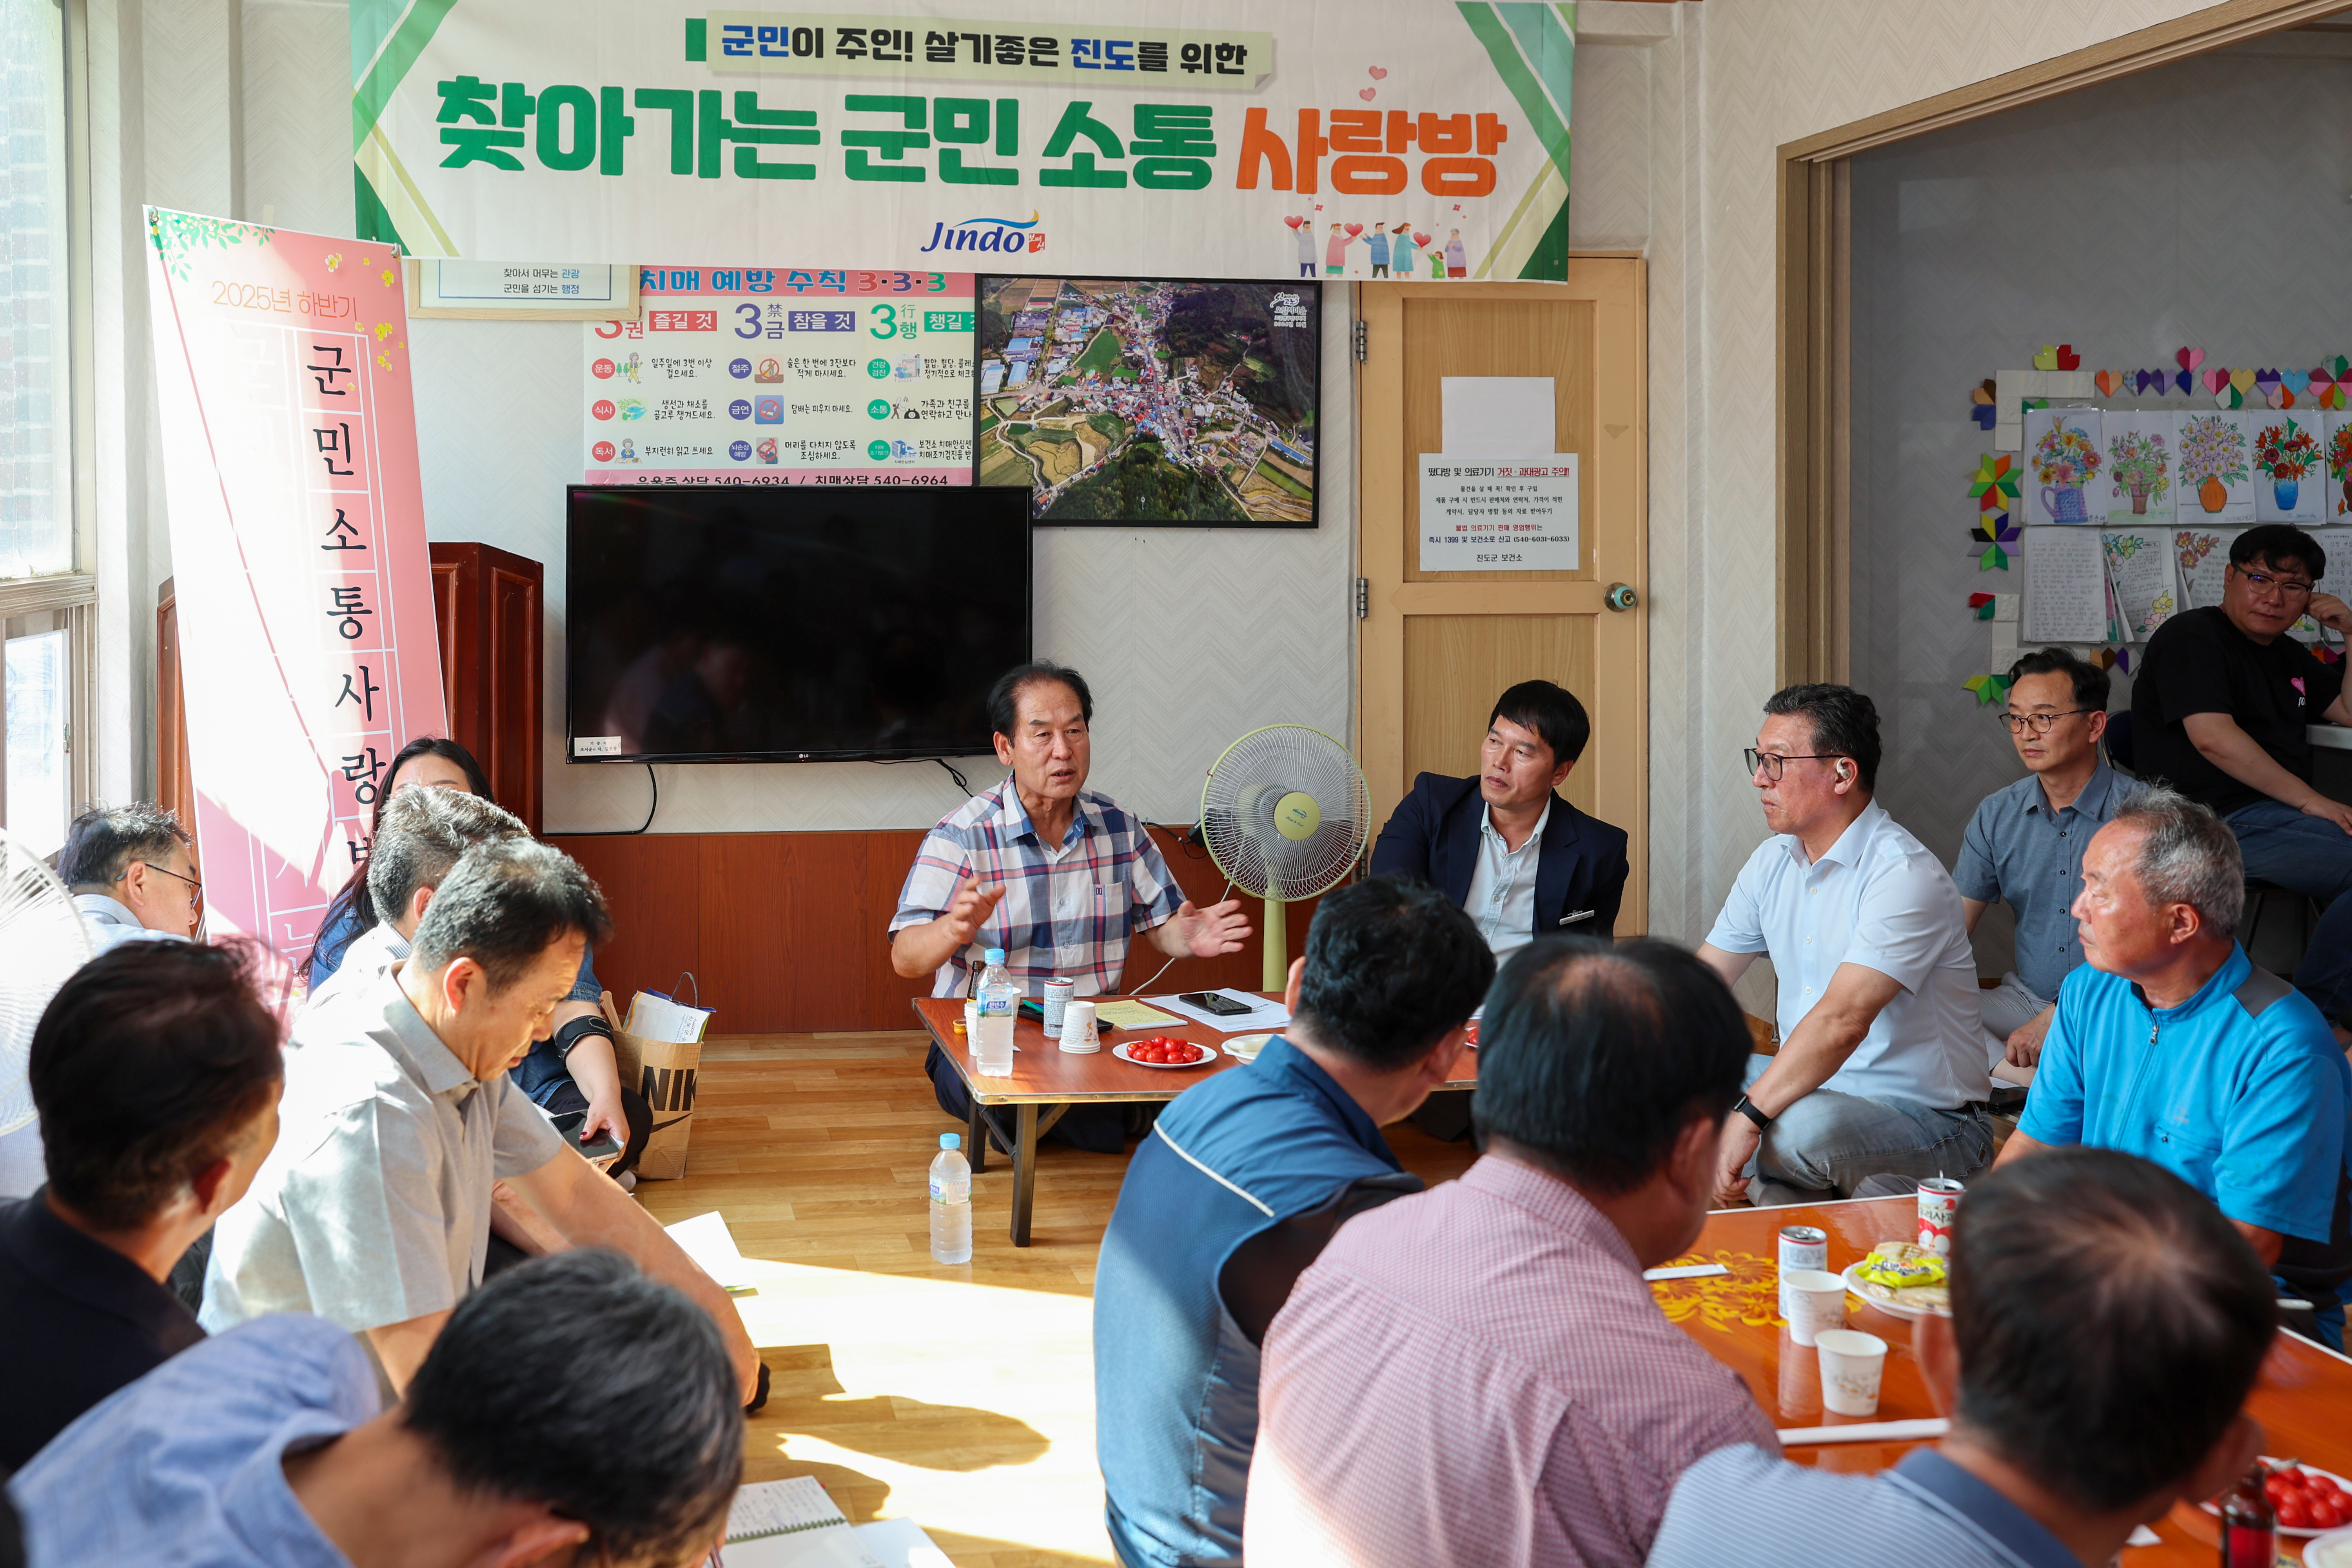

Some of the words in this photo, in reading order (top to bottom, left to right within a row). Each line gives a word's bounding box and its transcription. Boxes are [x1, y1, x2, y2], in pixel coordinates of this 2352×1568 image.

[722, 25, 824, 58] 군민이
[836, 28, 912, 62] 주인!
[925, 31, 1058, 67] 살기좋은
[1071, 38, 1168, 73] 진도를
[1180, 42, 1247, 75] 위한
[436, 75, 820, 180] 찾아가는
[841, 94, 1019, 186] 군민
[1039, 101, 1217, 191] 소통
[1236, 107, 1508, 197] 사랑방
[921, 222, 1025, 252] Jindo
[504, 268, 529, 278] 찾아서
[533, 269, 558, 278] 머무는
[562, 269, 580, 278] 관광
[640, 269, 700, 291] 치매
[711, 270, 776, 293] 예방
[786, 270, 846, 293] 수칙
[504, 284, 529, 293] 군민을
[533, 284, 558, 294] 섬기는
[561, 285, 579, 294] 행정
[211, 280, 292, 313] 2025년
[297, 291, 358, 321] 하반기
[653, 313, 688, 329] 즐길
[696, 313, 712, 329] 것
[735, 303, 762, 339] 3
[765, 321, 784, 339] 금
[793, 313, 827, 330] 참을
[835, 313, 850, 330] 것
[870, 304, 897, 339] 3
[900, 321, 916, 339] 행
[929, 314, 962, 330] 챙길
[652, 358, 680, 368] 일주일에
[683, 358, 695, 368] 3번
[698, 358, 712, 368] 이상
[787, 358, 800, 368] 술은
[803, 358, 810, 367] 한
[812, 358, 827, 367] 번에
[830, 359, 856, 367] 3잔보다
[924, 358, 939, 368] 혈압,
[941, 358, 956, 368] 혈당,
[595, 365, 612, 373] 운동
[731, 364, 749, 373] 절주
[667, 369, 697, 379] 걸으세요.
[797, 369, 812, 379] 적게
[815, 369, 846, 378] 마시세요.
[924, 369, 955, 379] 정기적으로
[661, 399, 684, 410] 생선과
[687, 399, 708, 410] 채소를
[791, 404, 810, 414] 담배는
[812, 404, 830, 414] 피우지
[832, 405, 853, 413] 마세요.
[921, 399, 945, 409] 가족과
[947, 399, 969, 409] 친구를
[595, 406, 613, 415] 식사
[731, 405, 749, 414] 금연
[870, 405, 888, 414] 소통
[654, 411, 674, 420] 골고루
[677, 410, 715, 420] 챙겨드세요.
[921, 410, 953, 420] 연락하고
[785, 440, 806, 450] 머리를
[810, 441, 832, 449] 다치지
[835, 440, 856, 450] 않도록
[919, 440, 937, 449] 보건소
[595, 447, 613, 456] 독서
[645, 446, 673, 456] 부지런히
[676, 446, 690, 456] 읽고
[692, 446, 713, 455] 쓰세요
[919, 450, 963, 460] 치매조기검진을
[800, 452, 840, 461] 조심하세요.
[1428, 468, 1451, 477] 떴다방
[1454, 468, 1461, 476] 및
[1465, 468, 1494, 476] 의료기기
[1497, 467, 1512, 476] 거짓
[1519, 467, 1548, 476] 과대광고
